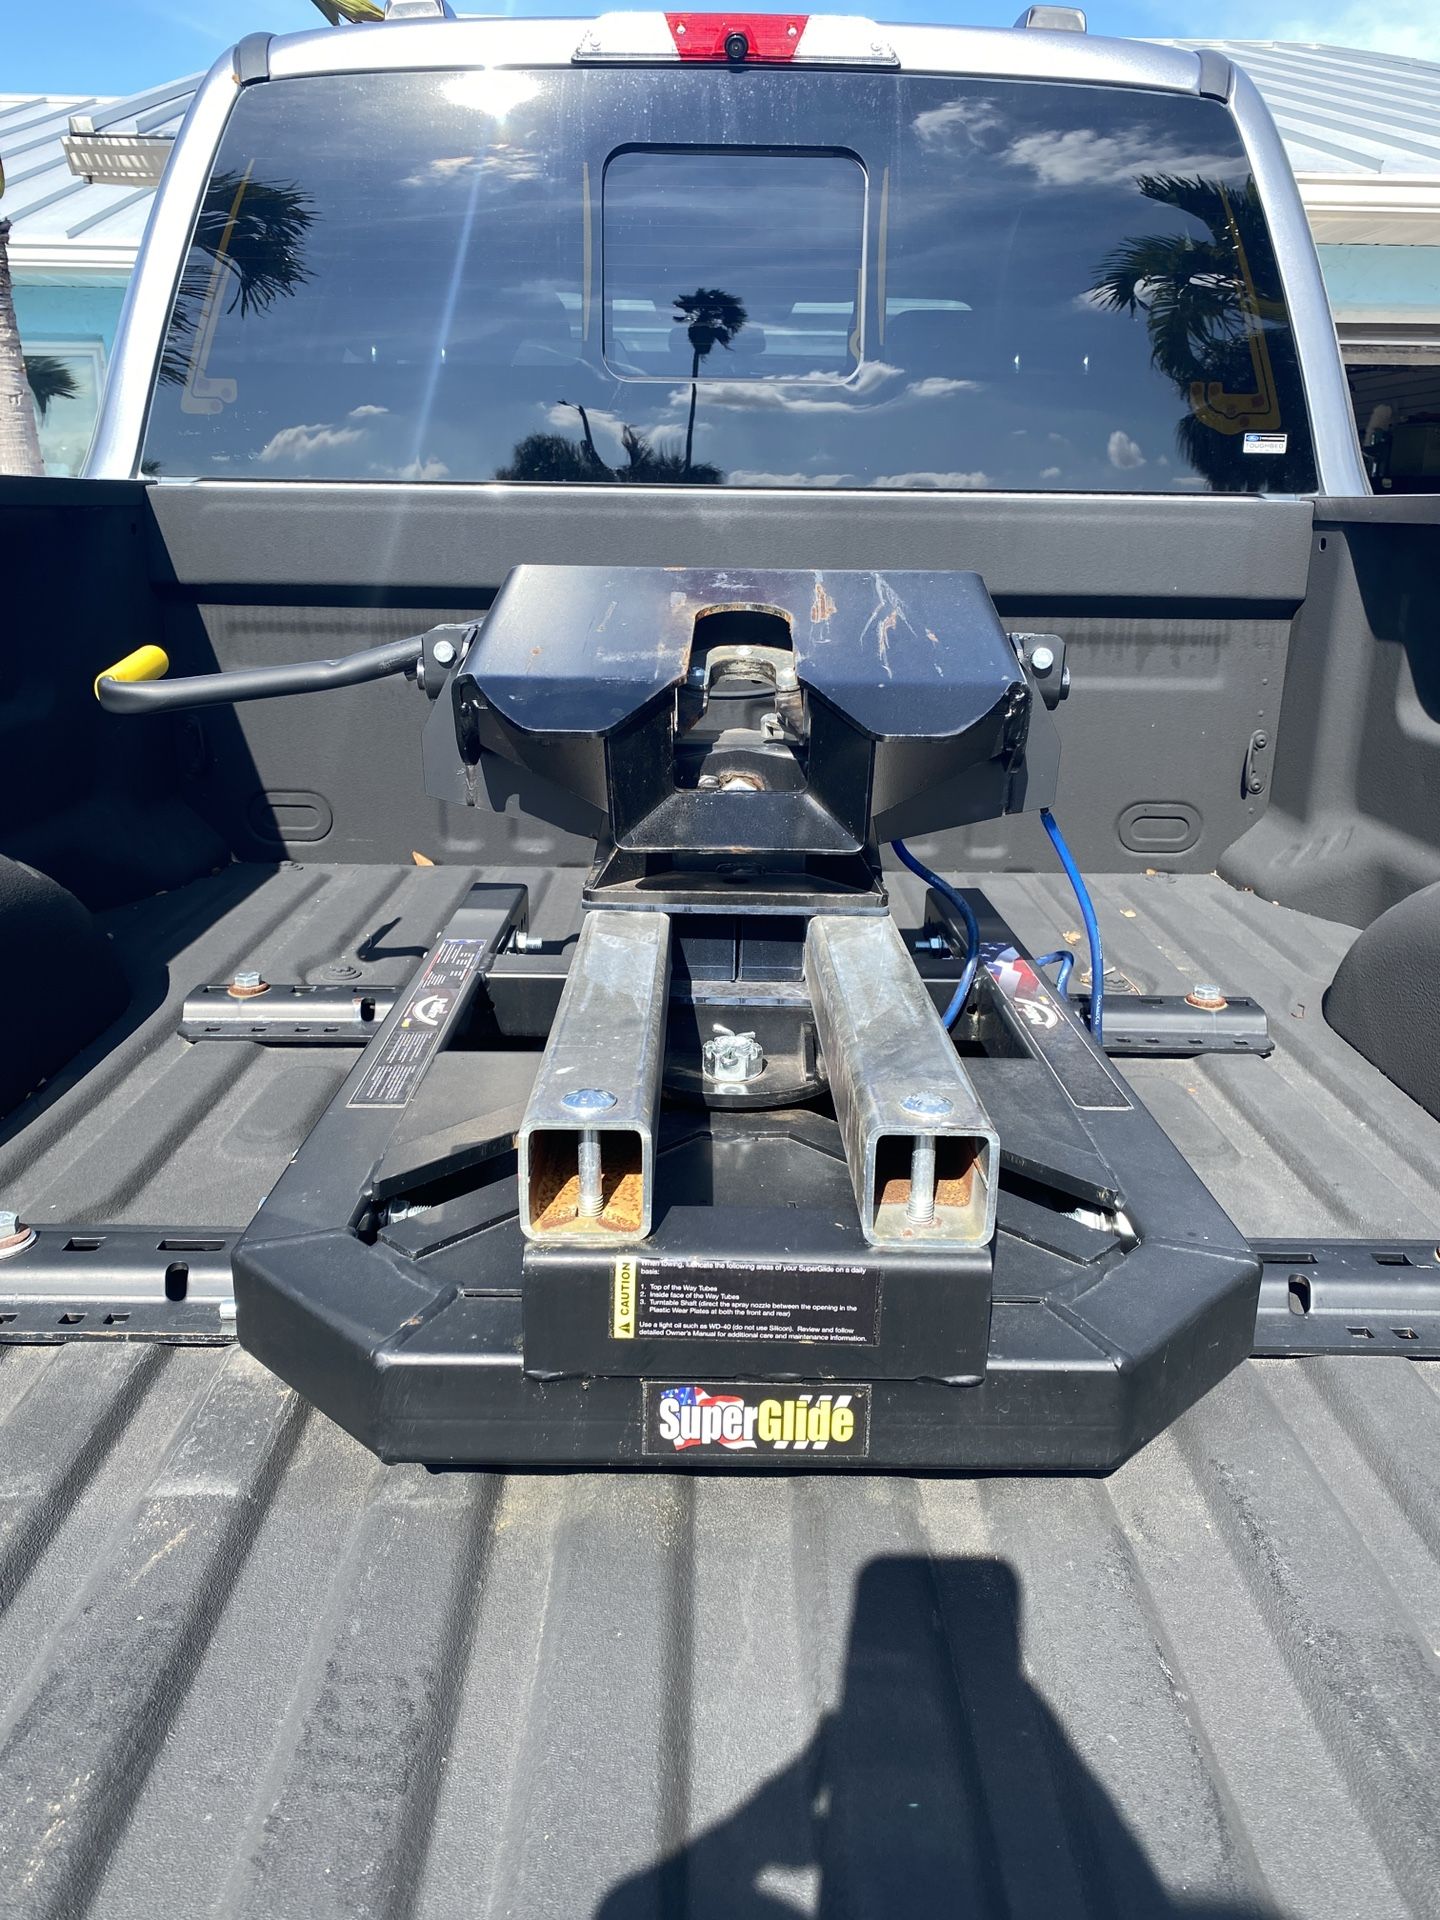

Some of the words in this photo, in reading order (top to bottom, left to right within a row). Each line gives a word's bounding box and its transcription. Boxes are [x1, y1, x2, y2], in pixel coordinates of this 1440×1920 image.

[726, 1261, 754, 1271] following
[621, 1262, 631, 1316] CAUTION
[659, 1322, 673, 1330] light
[659, 1398, 854, 1444] SuperGlide
